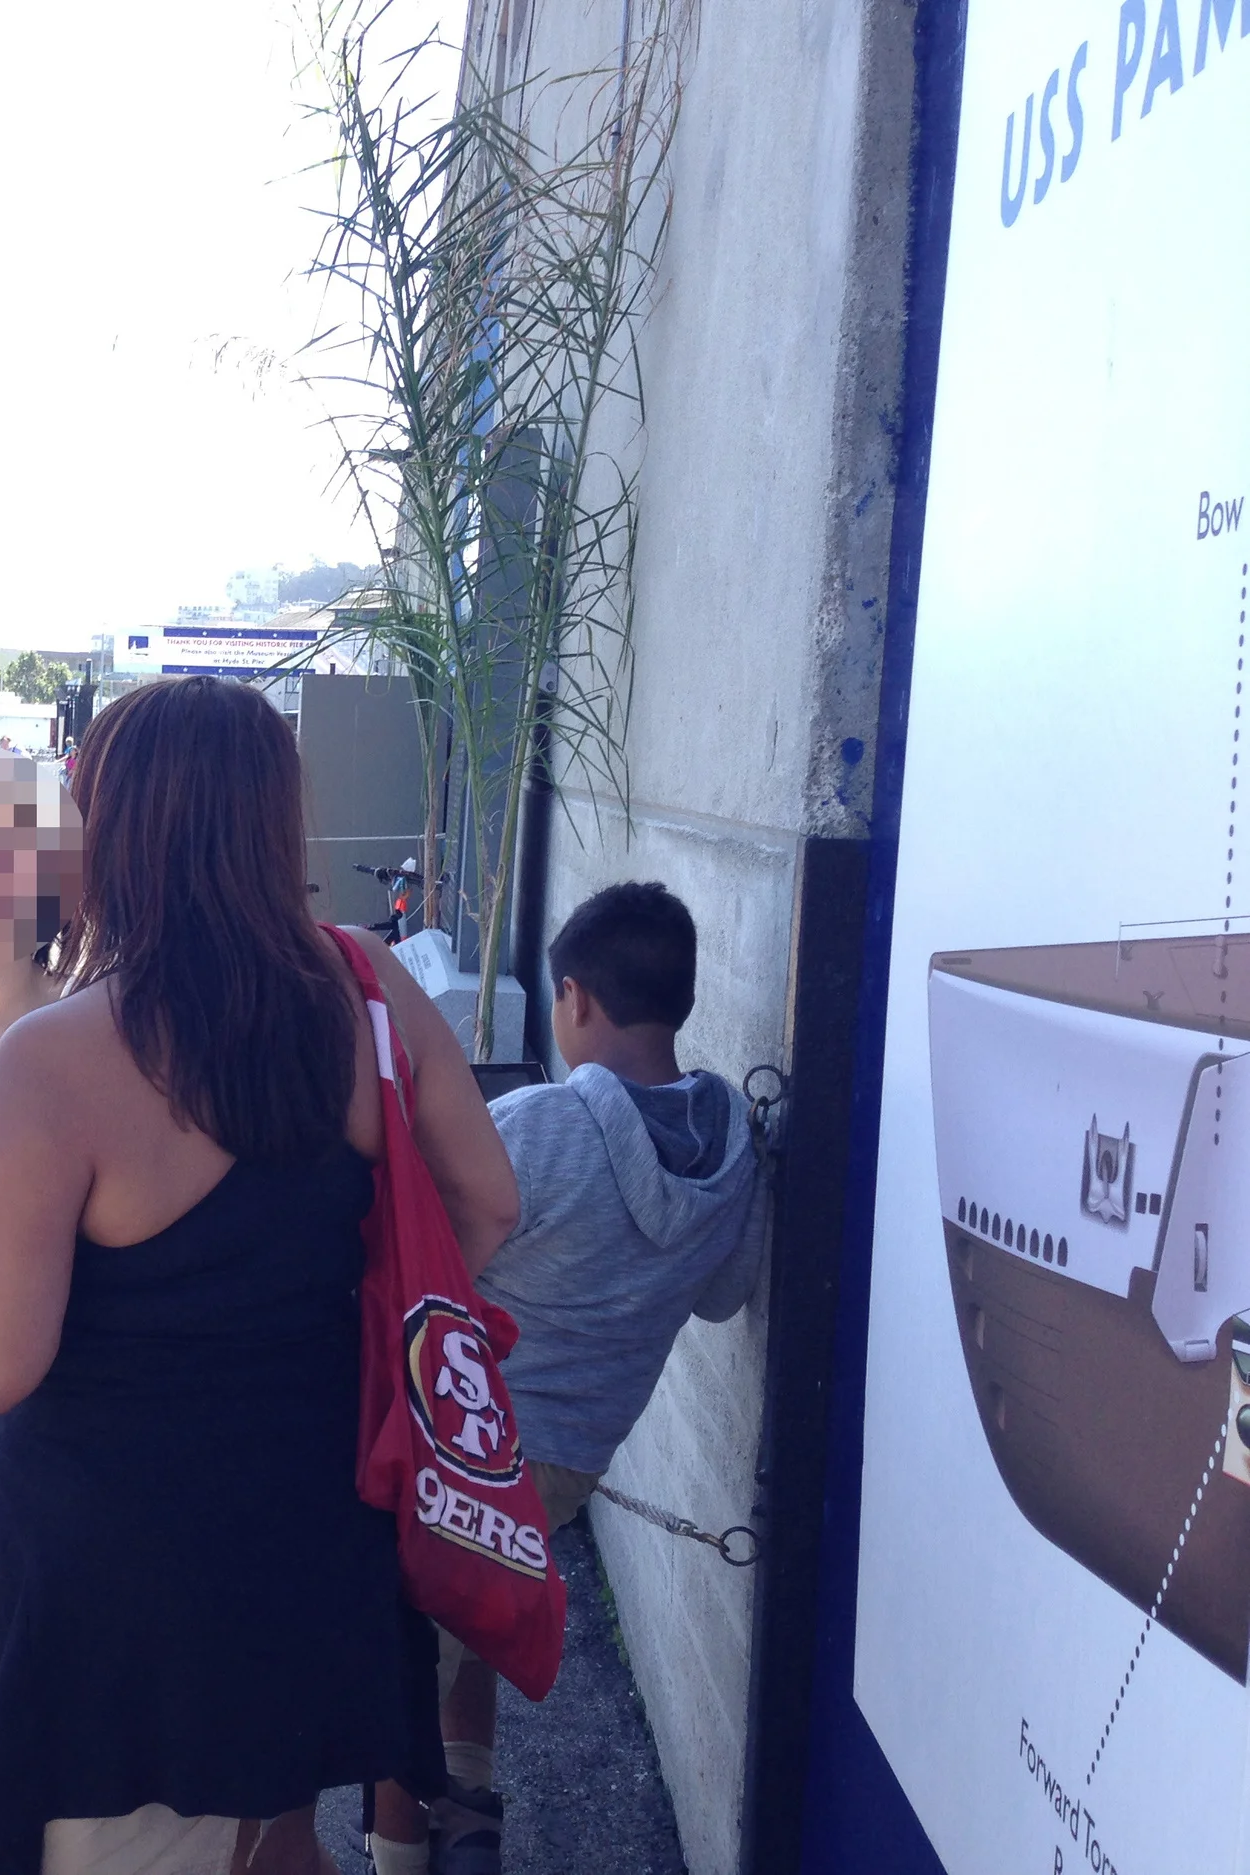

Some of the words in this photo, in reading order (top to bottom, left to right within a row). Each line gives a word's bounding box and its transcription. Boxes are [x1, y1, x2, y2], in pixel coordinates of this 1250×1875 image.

[1000, 40, 1089, 228] USS
[1197, 490, 1244, 540] Bow
[167, 638, 191, 646] THANK
[289, 641, 304, 649] PIER
[434, 1330, 507, 1460] SF
[416, 1466, 548, 1570] 9ERS
[1019, 1716, 1080, 1842] Forward
[1083, 1807, 1119, 1875] Tor
